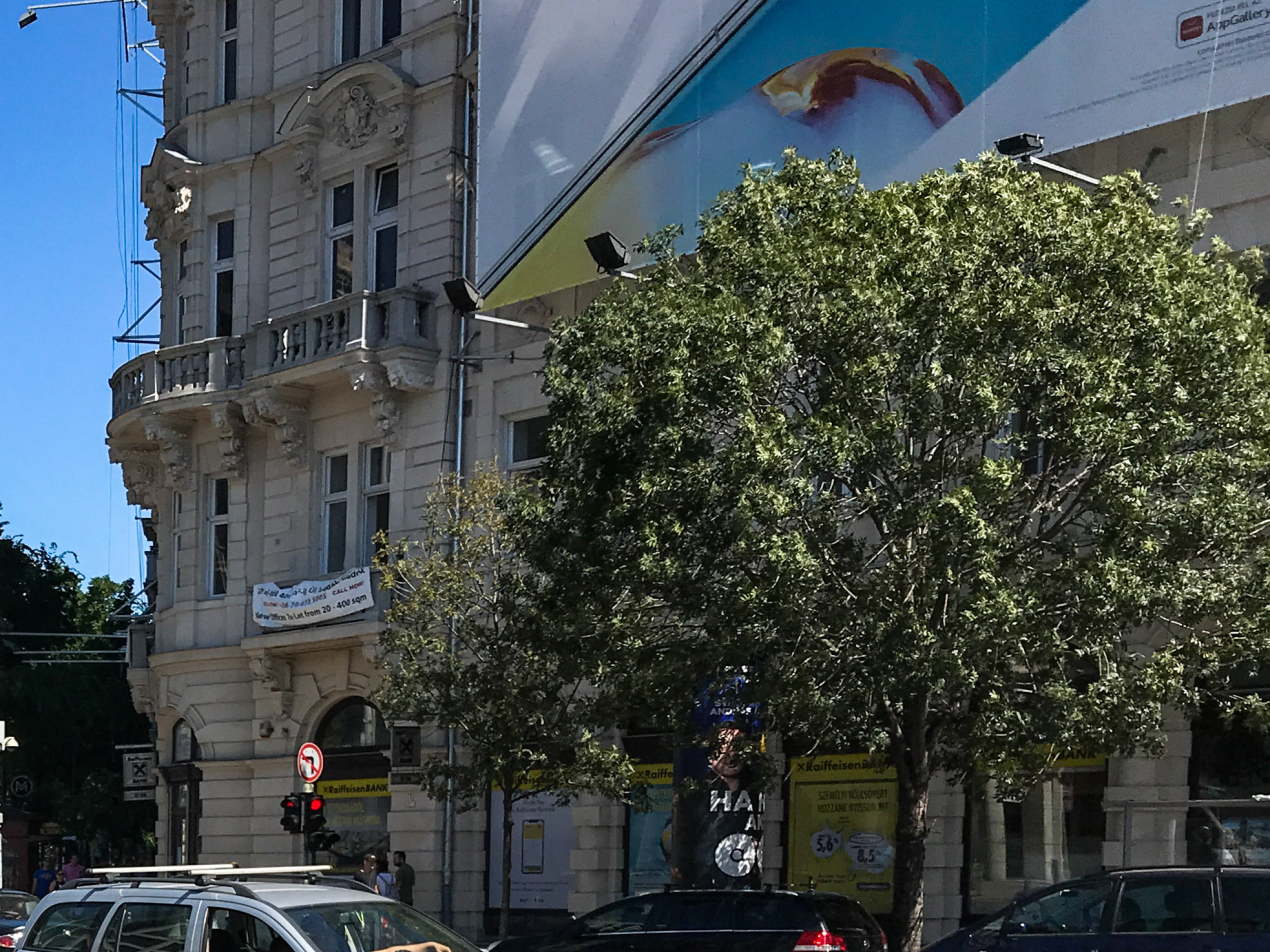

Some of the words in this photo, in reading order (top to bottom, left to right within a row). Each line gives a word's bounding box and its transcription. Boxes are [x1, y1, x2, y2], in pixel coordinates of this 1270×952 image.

[1206, 8, 1270, 33] AppGallery
[304, 608, 322, 618] from
[321, 605, 332, 614] 20
[351, 593, 368, 606] sqm
